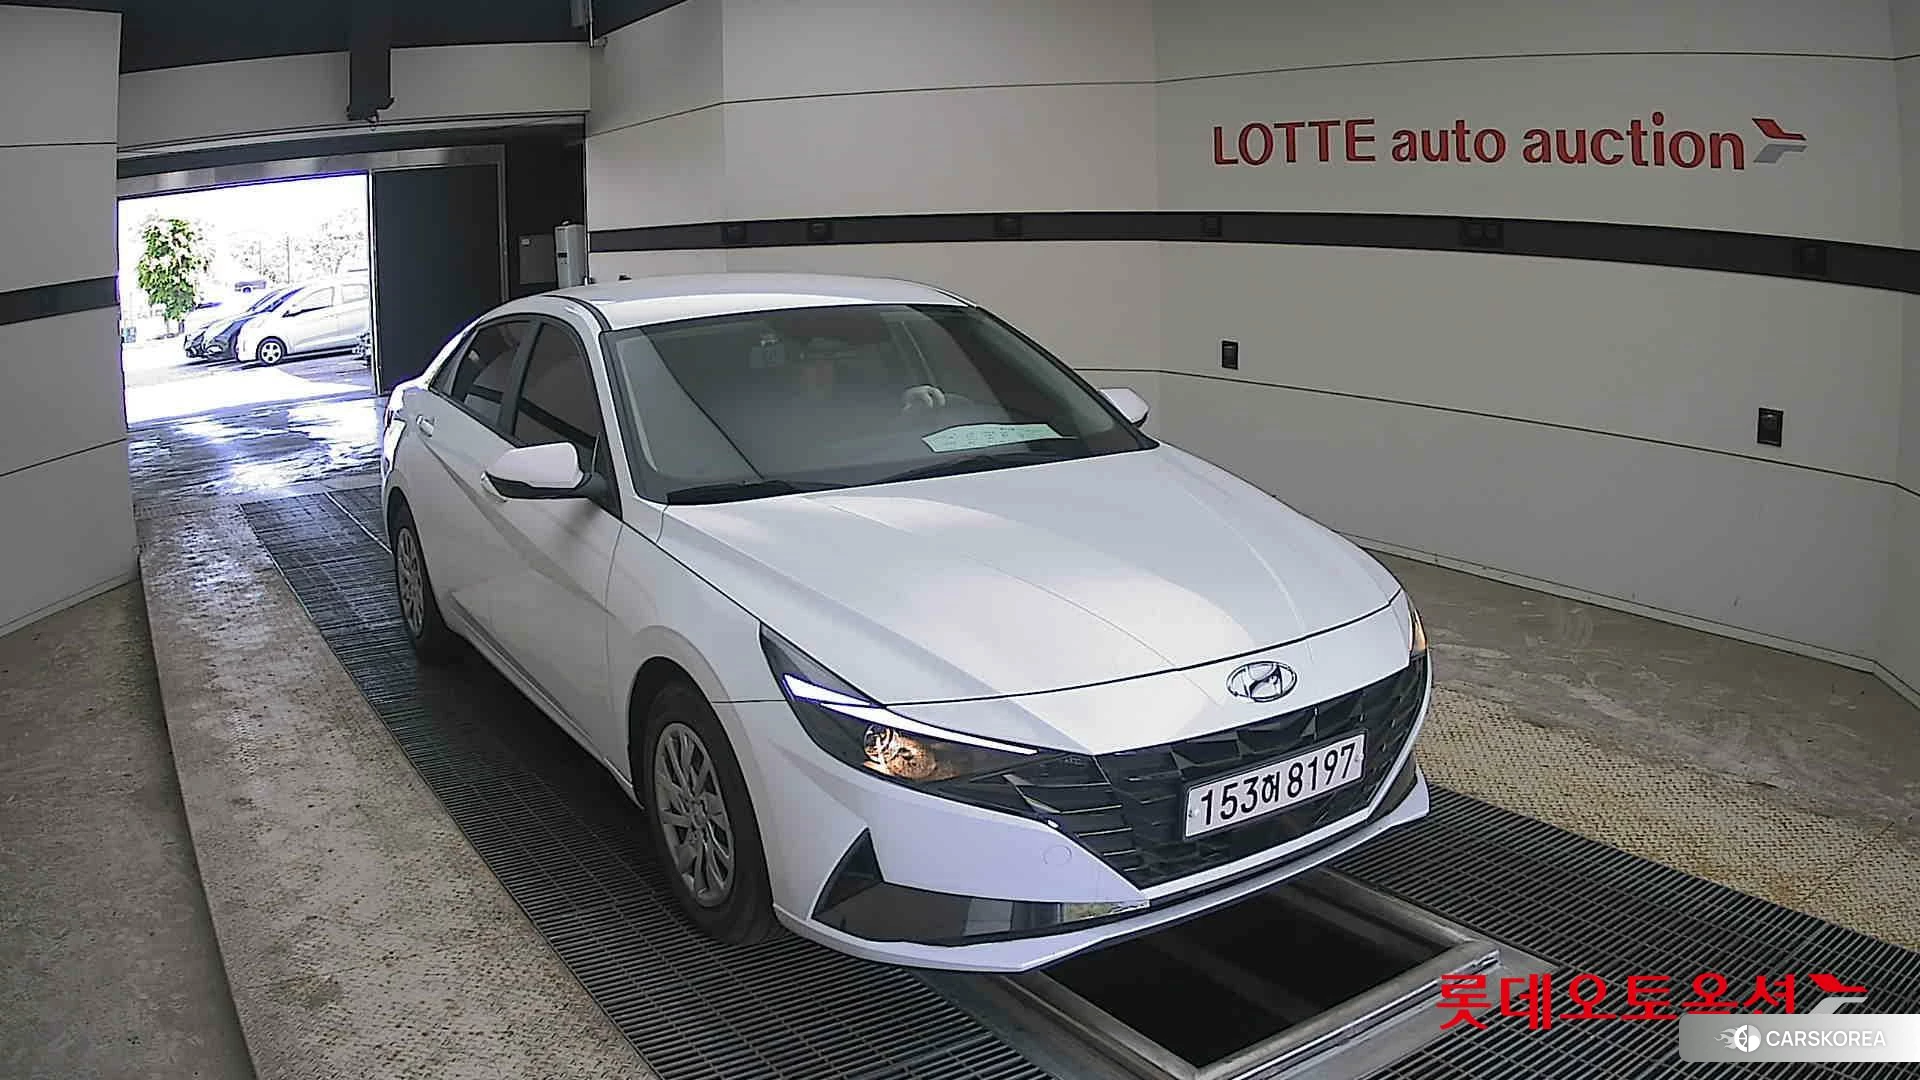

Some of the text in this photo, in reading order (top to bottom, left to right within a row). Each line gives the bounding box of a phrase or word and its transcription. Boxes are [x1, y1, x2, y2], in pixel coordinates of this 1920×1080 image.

[1212, 111, 1745, 171] LOTTE auto auction
